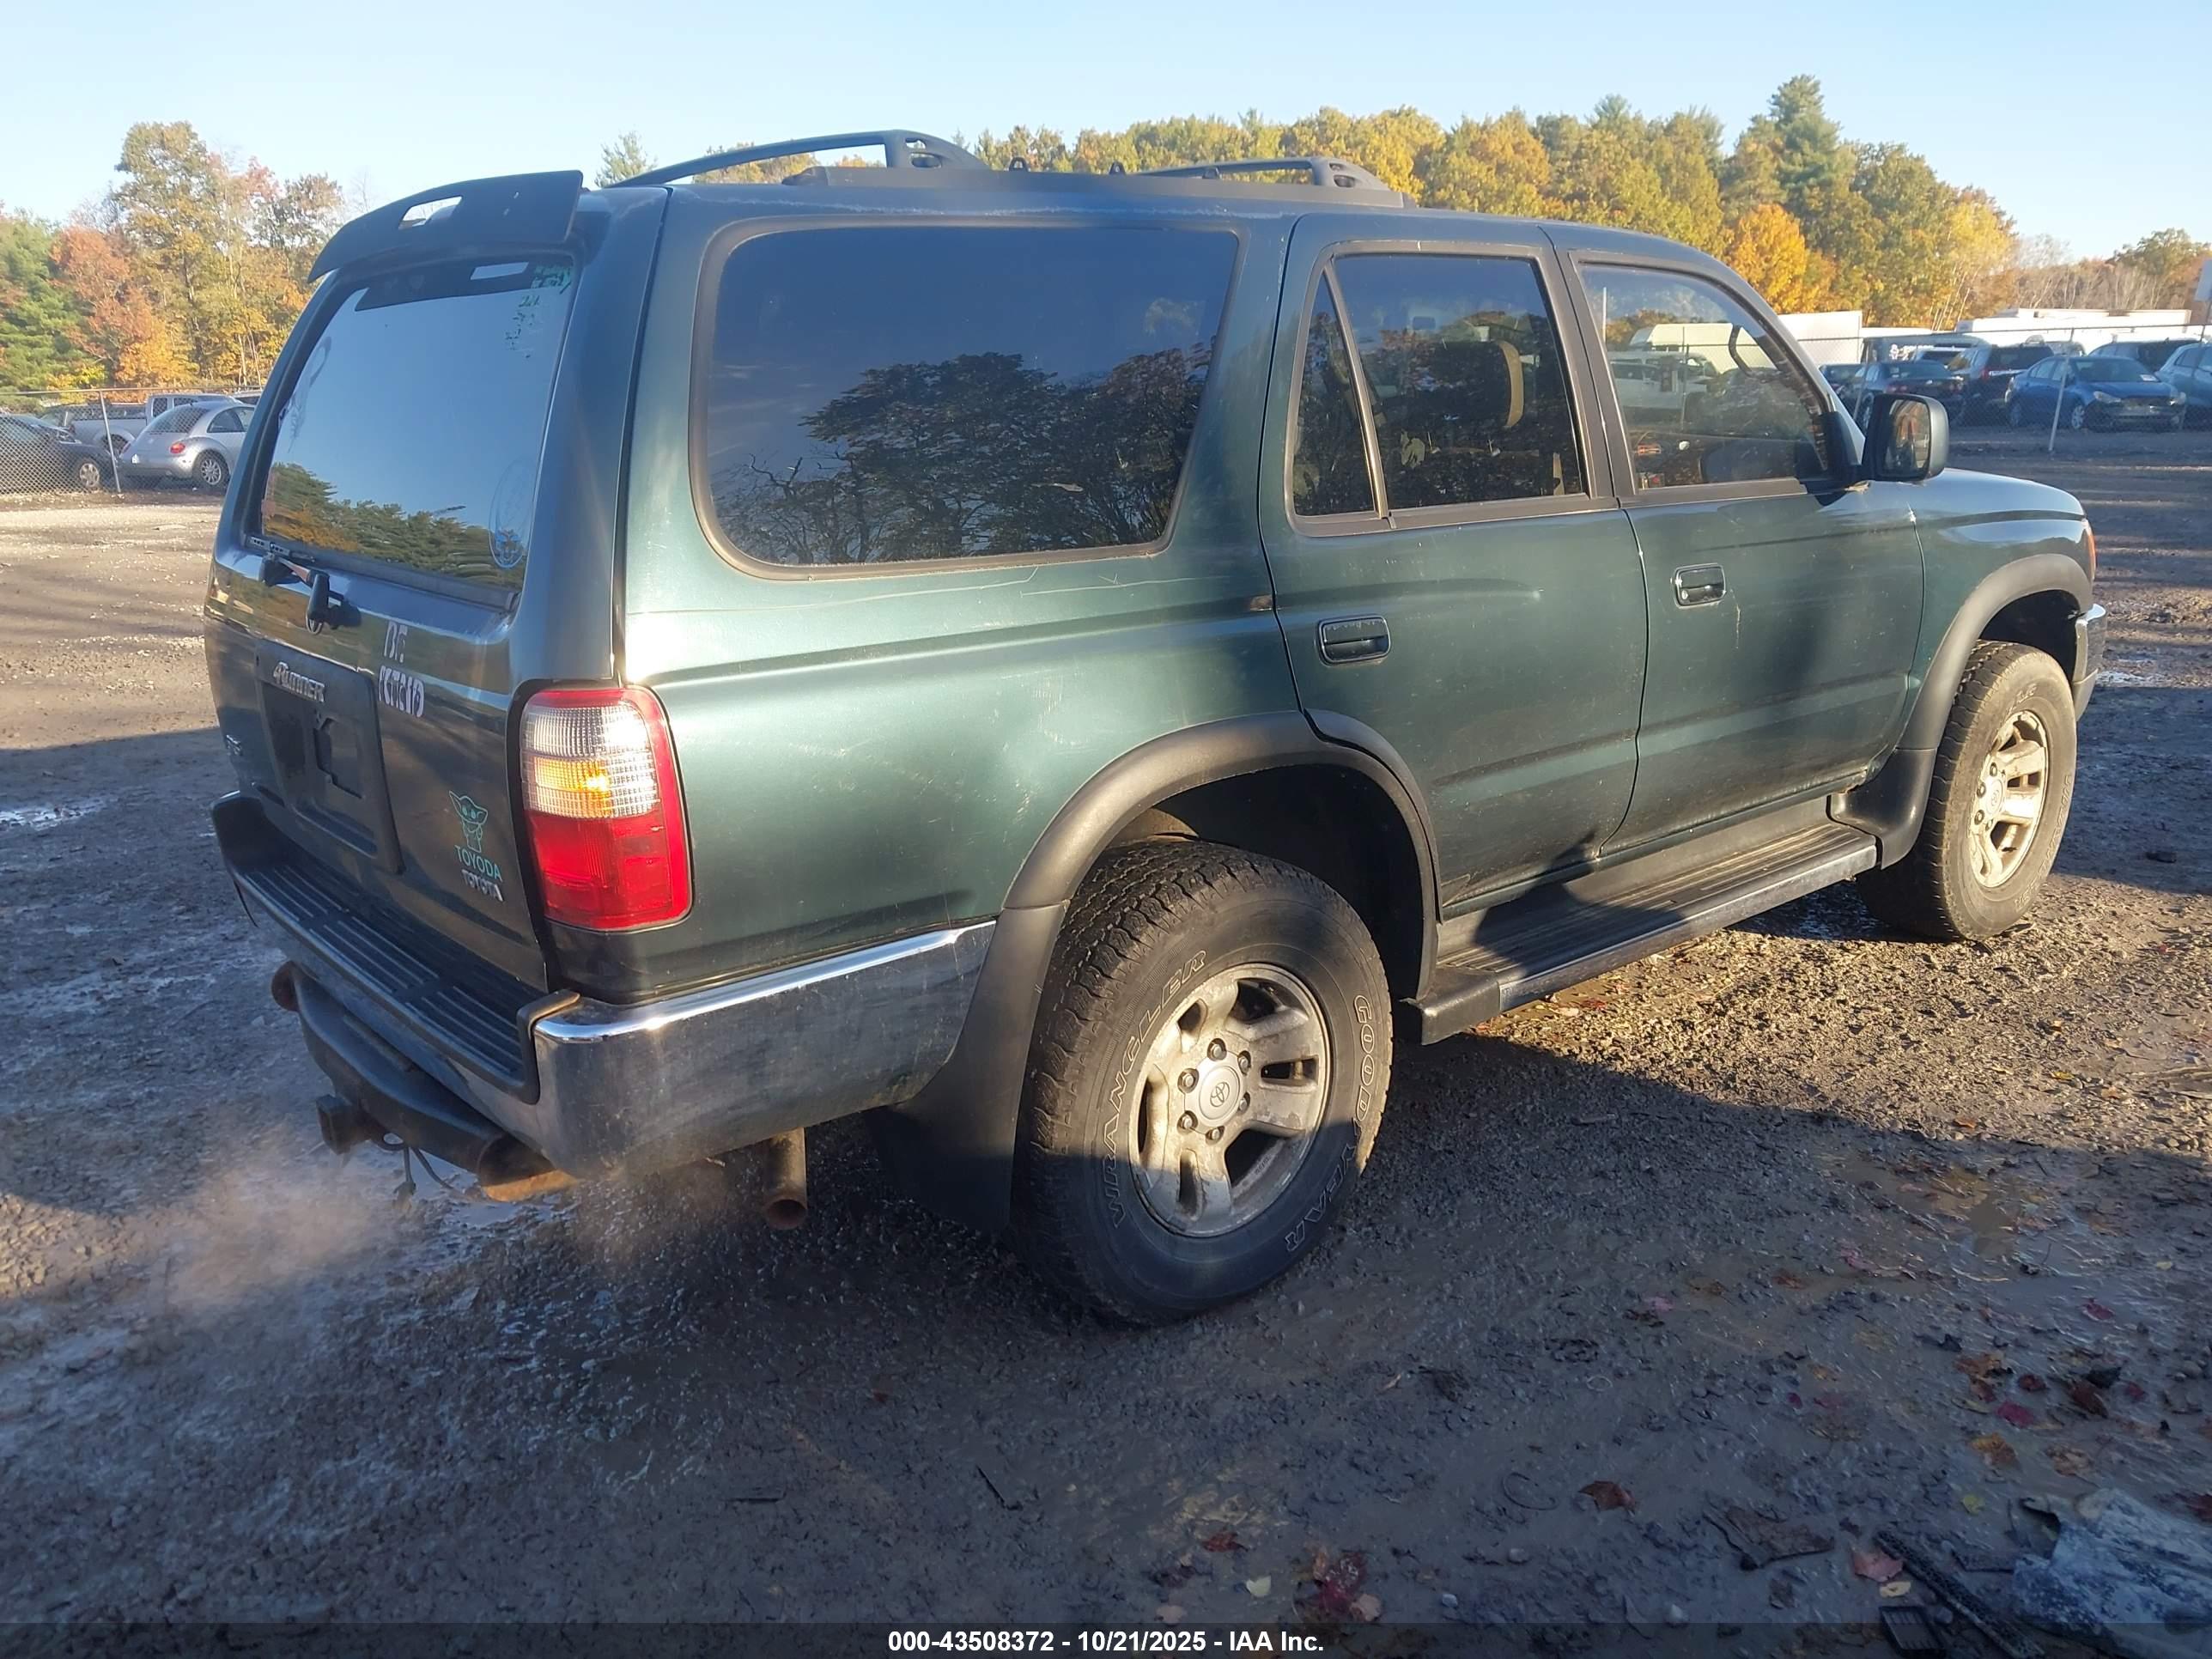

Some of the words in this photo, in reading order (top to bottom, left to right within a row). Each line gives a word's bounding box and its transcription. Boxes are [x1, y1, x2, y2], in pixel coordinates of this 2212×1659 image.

[454, 844, 503, 883] TOYODA
[462, 868, 503, 902] TOYOTA
[1103, 950, 1206, 1228] WRANGLER
[1285, 995, 1376, 1253] GOODYEAR
